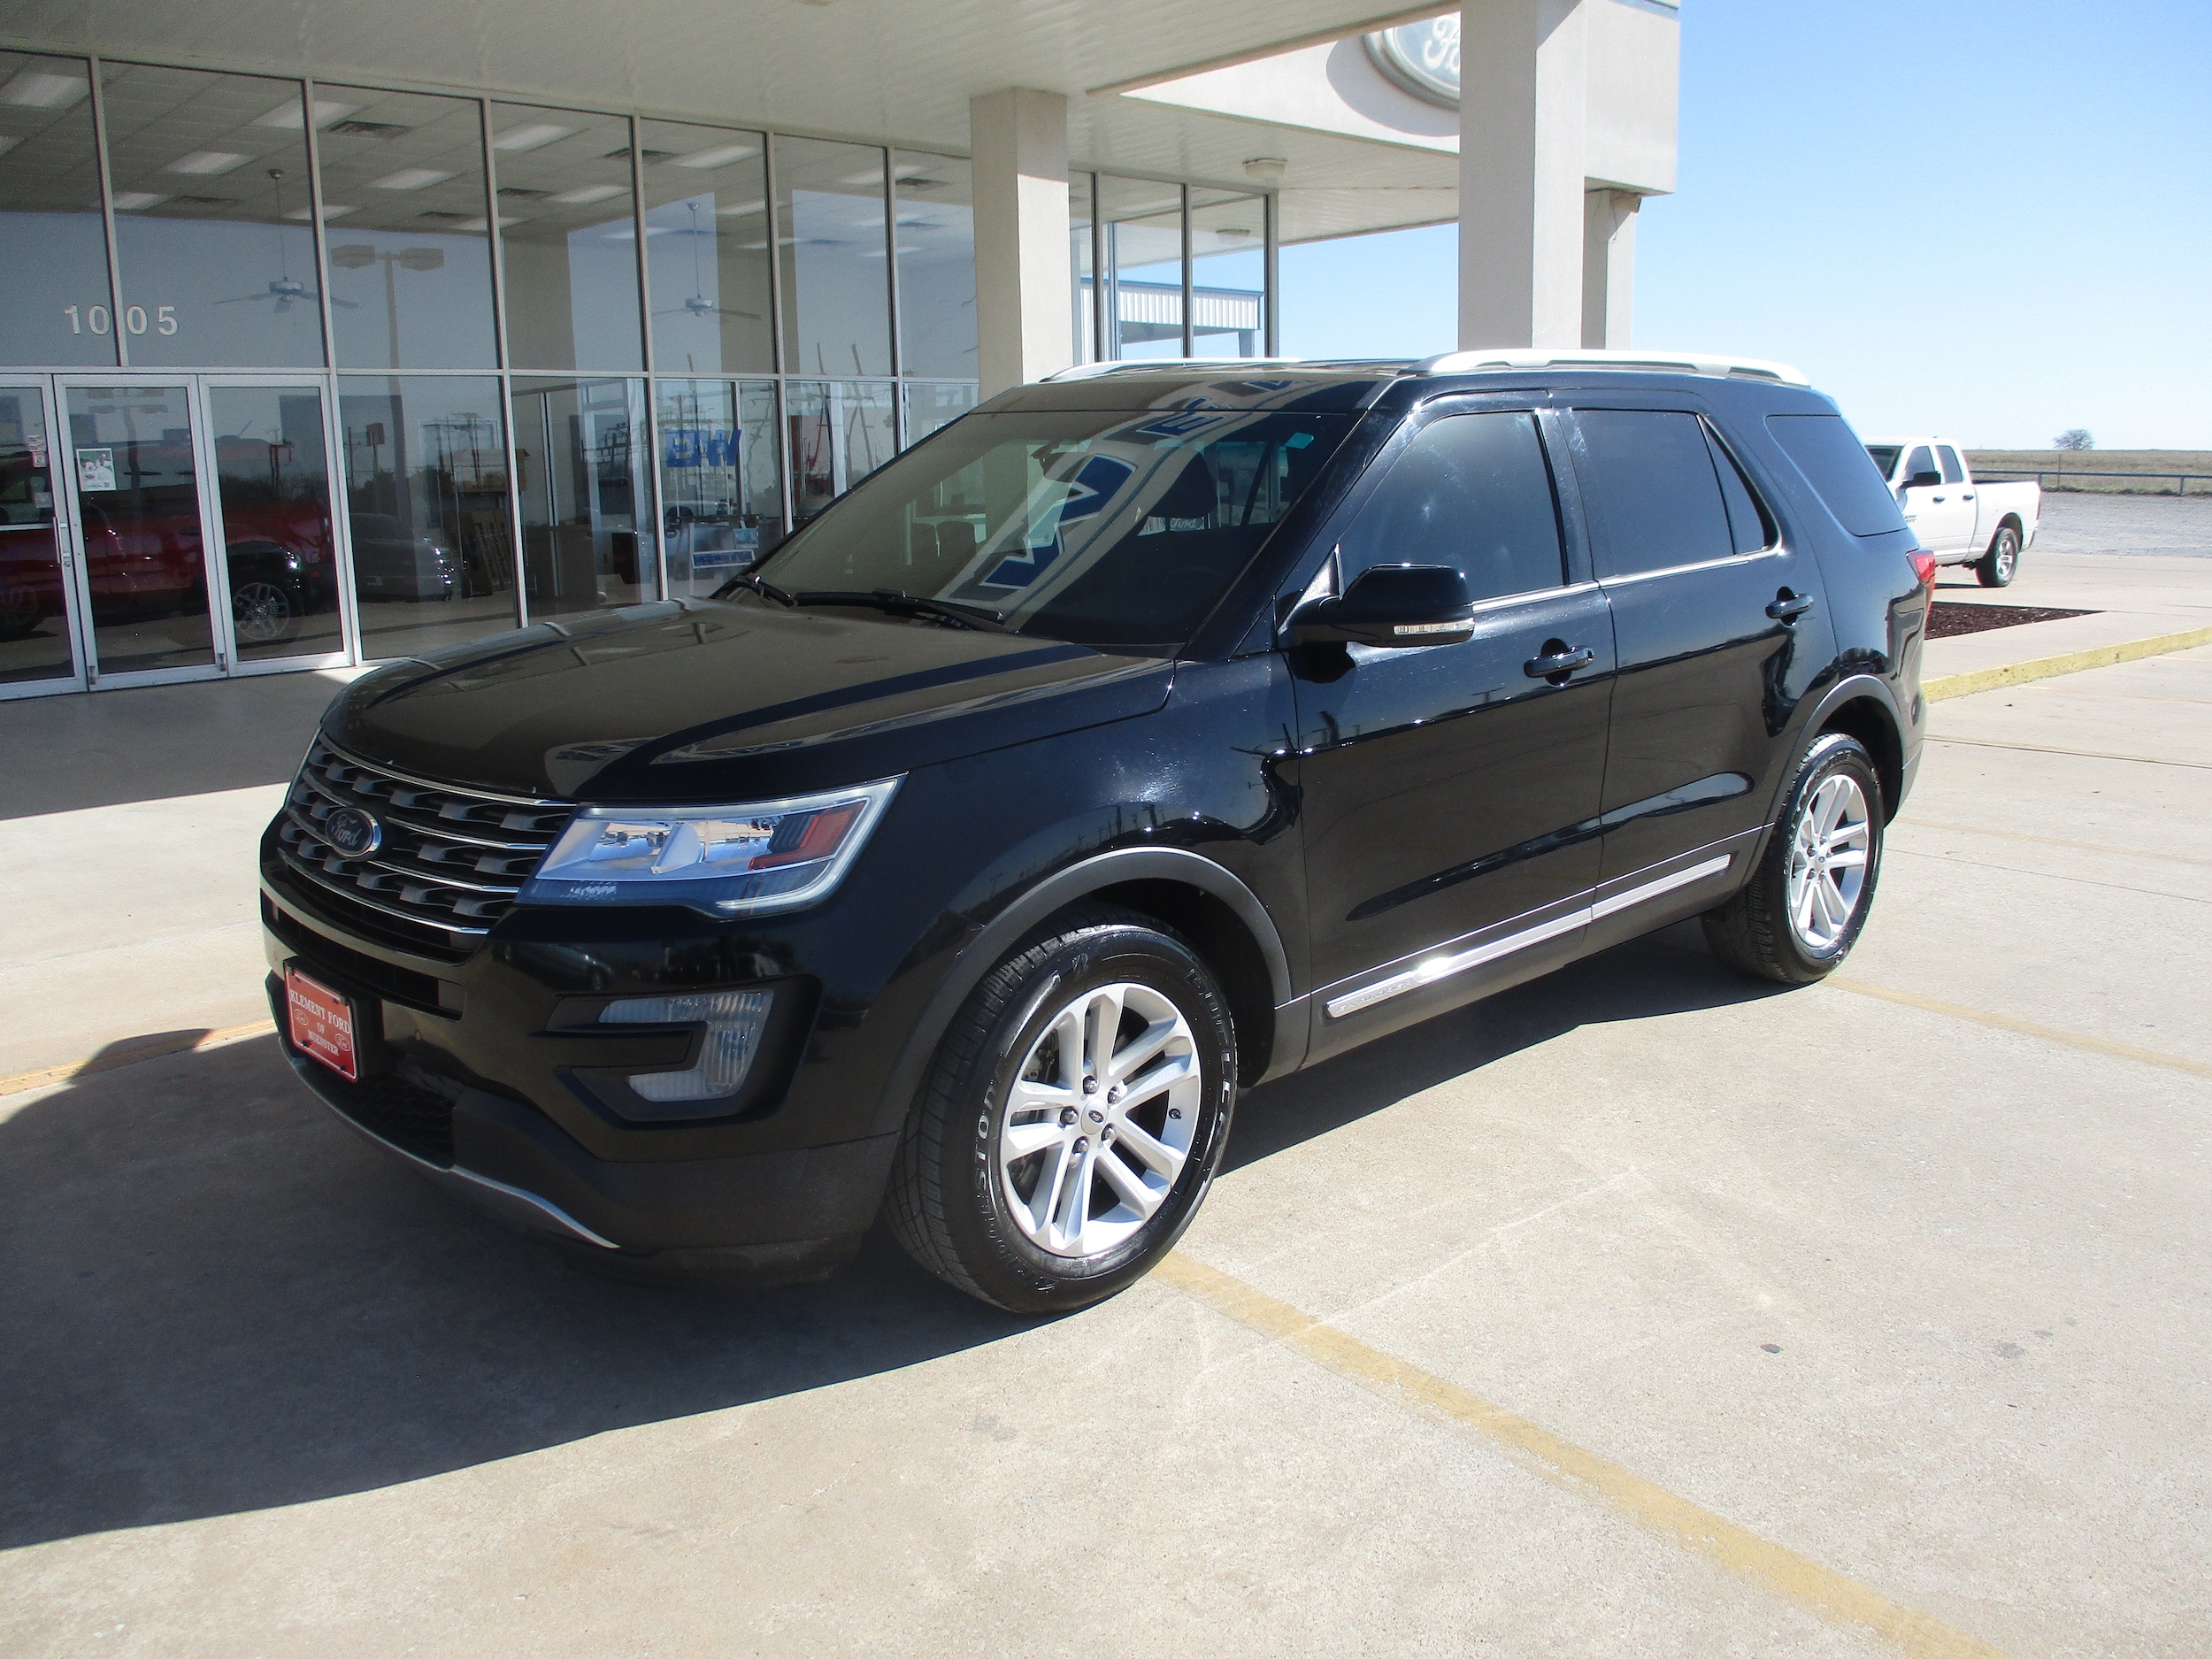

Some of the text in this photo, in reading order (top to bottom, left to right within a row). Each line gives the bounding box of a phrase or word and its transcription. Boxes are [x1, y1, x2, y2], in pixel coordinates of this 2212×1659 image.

[64, 304, 178, 335] 1005
[331, 813, 363, 847] Ford
[289, 989, 350, 1034] KLEMENT FORD
[307, 1029, 340, 1056] MUENSTER
[317, 1022, 326, 1033] OF
